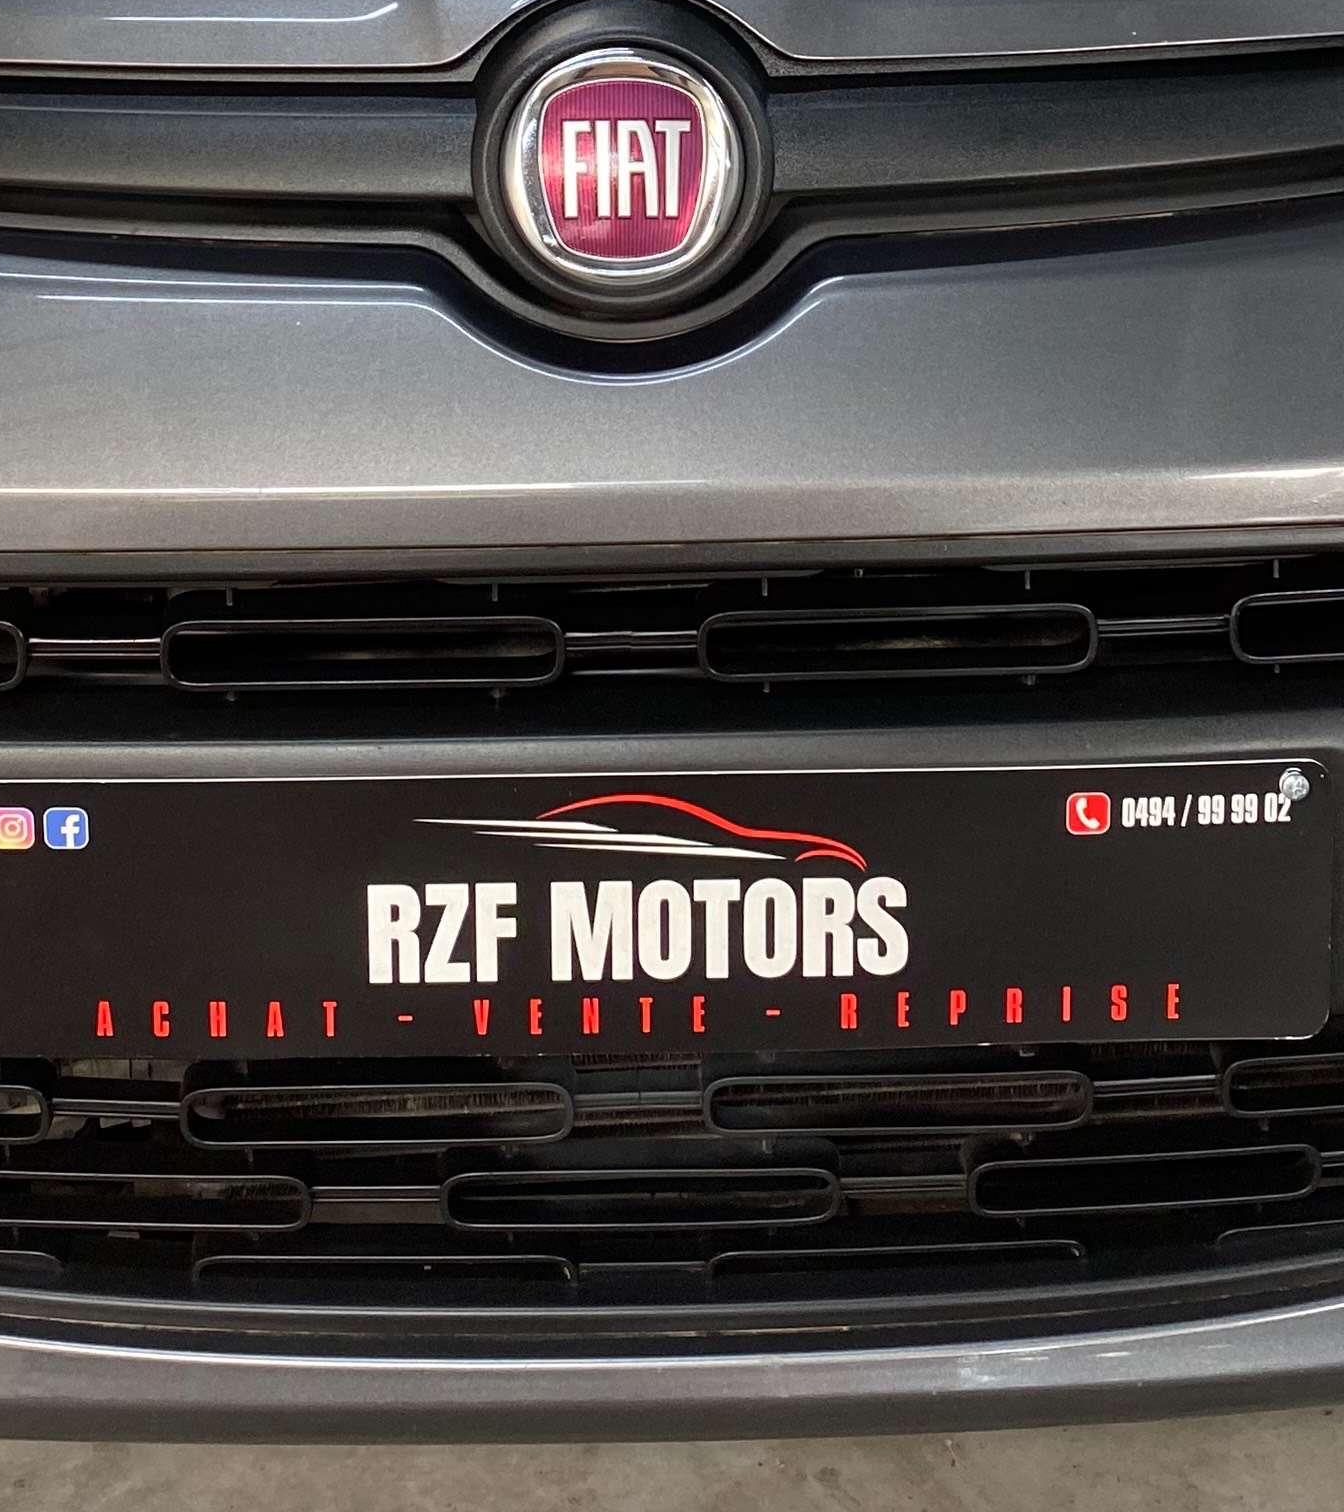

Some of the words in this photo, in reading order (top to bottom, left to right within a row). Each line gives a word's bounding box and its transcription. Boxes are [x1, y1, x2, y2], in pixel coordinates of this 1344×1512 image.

[561, 119, 692, 219] FIAT
[1121, 796, 1176, 828] 0494
[1197, 794, 1226, 825] 99
[1230, 793, 1258, 824] 99
[1263, 792, 1292, 823] 02
[366, 882, 518, 985] RZF
[549, 877, 909, 982] MOTORS
[96, 999, 338, 1037] ACHAT
[473, 996, 706, 1035] VENTE
[839, 983, 1181, 1030] REPRISE
